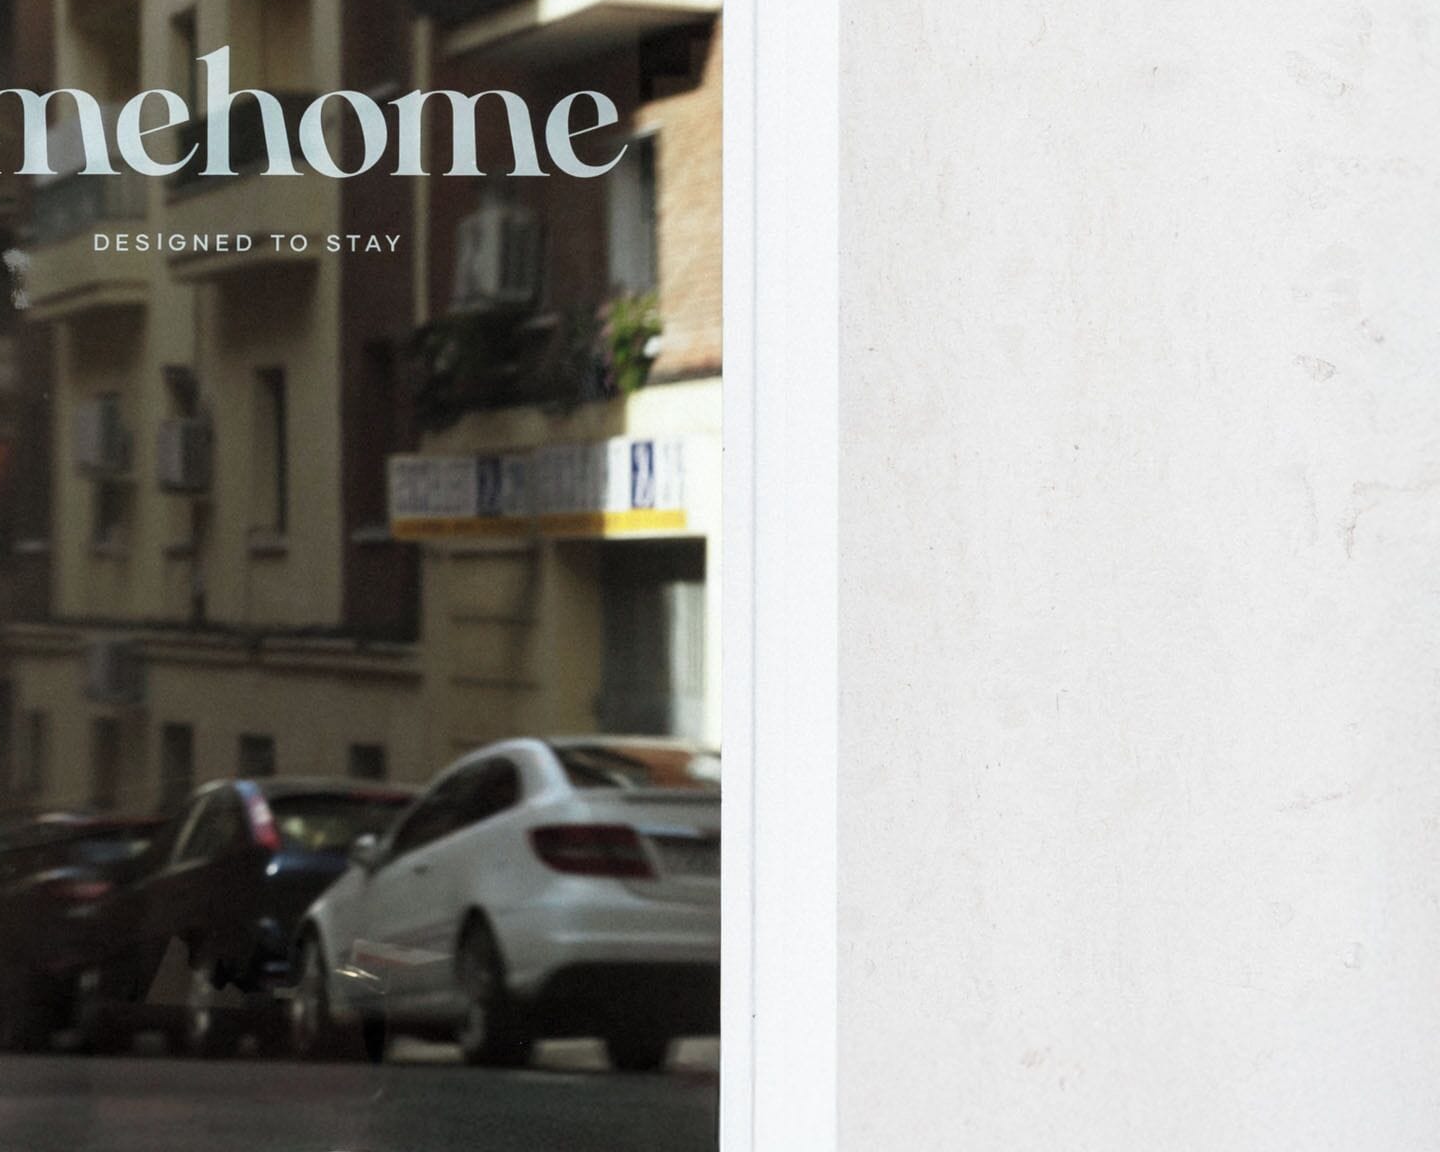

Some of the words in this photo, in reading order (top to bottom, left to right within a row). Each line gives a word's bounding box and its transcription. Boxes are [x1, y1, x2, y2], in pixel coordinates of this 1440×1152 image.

[94, 232, 252, 253] DESIGNED
[270, 232, 308, 253] TO
[326, 232, 400, 253] STAY
